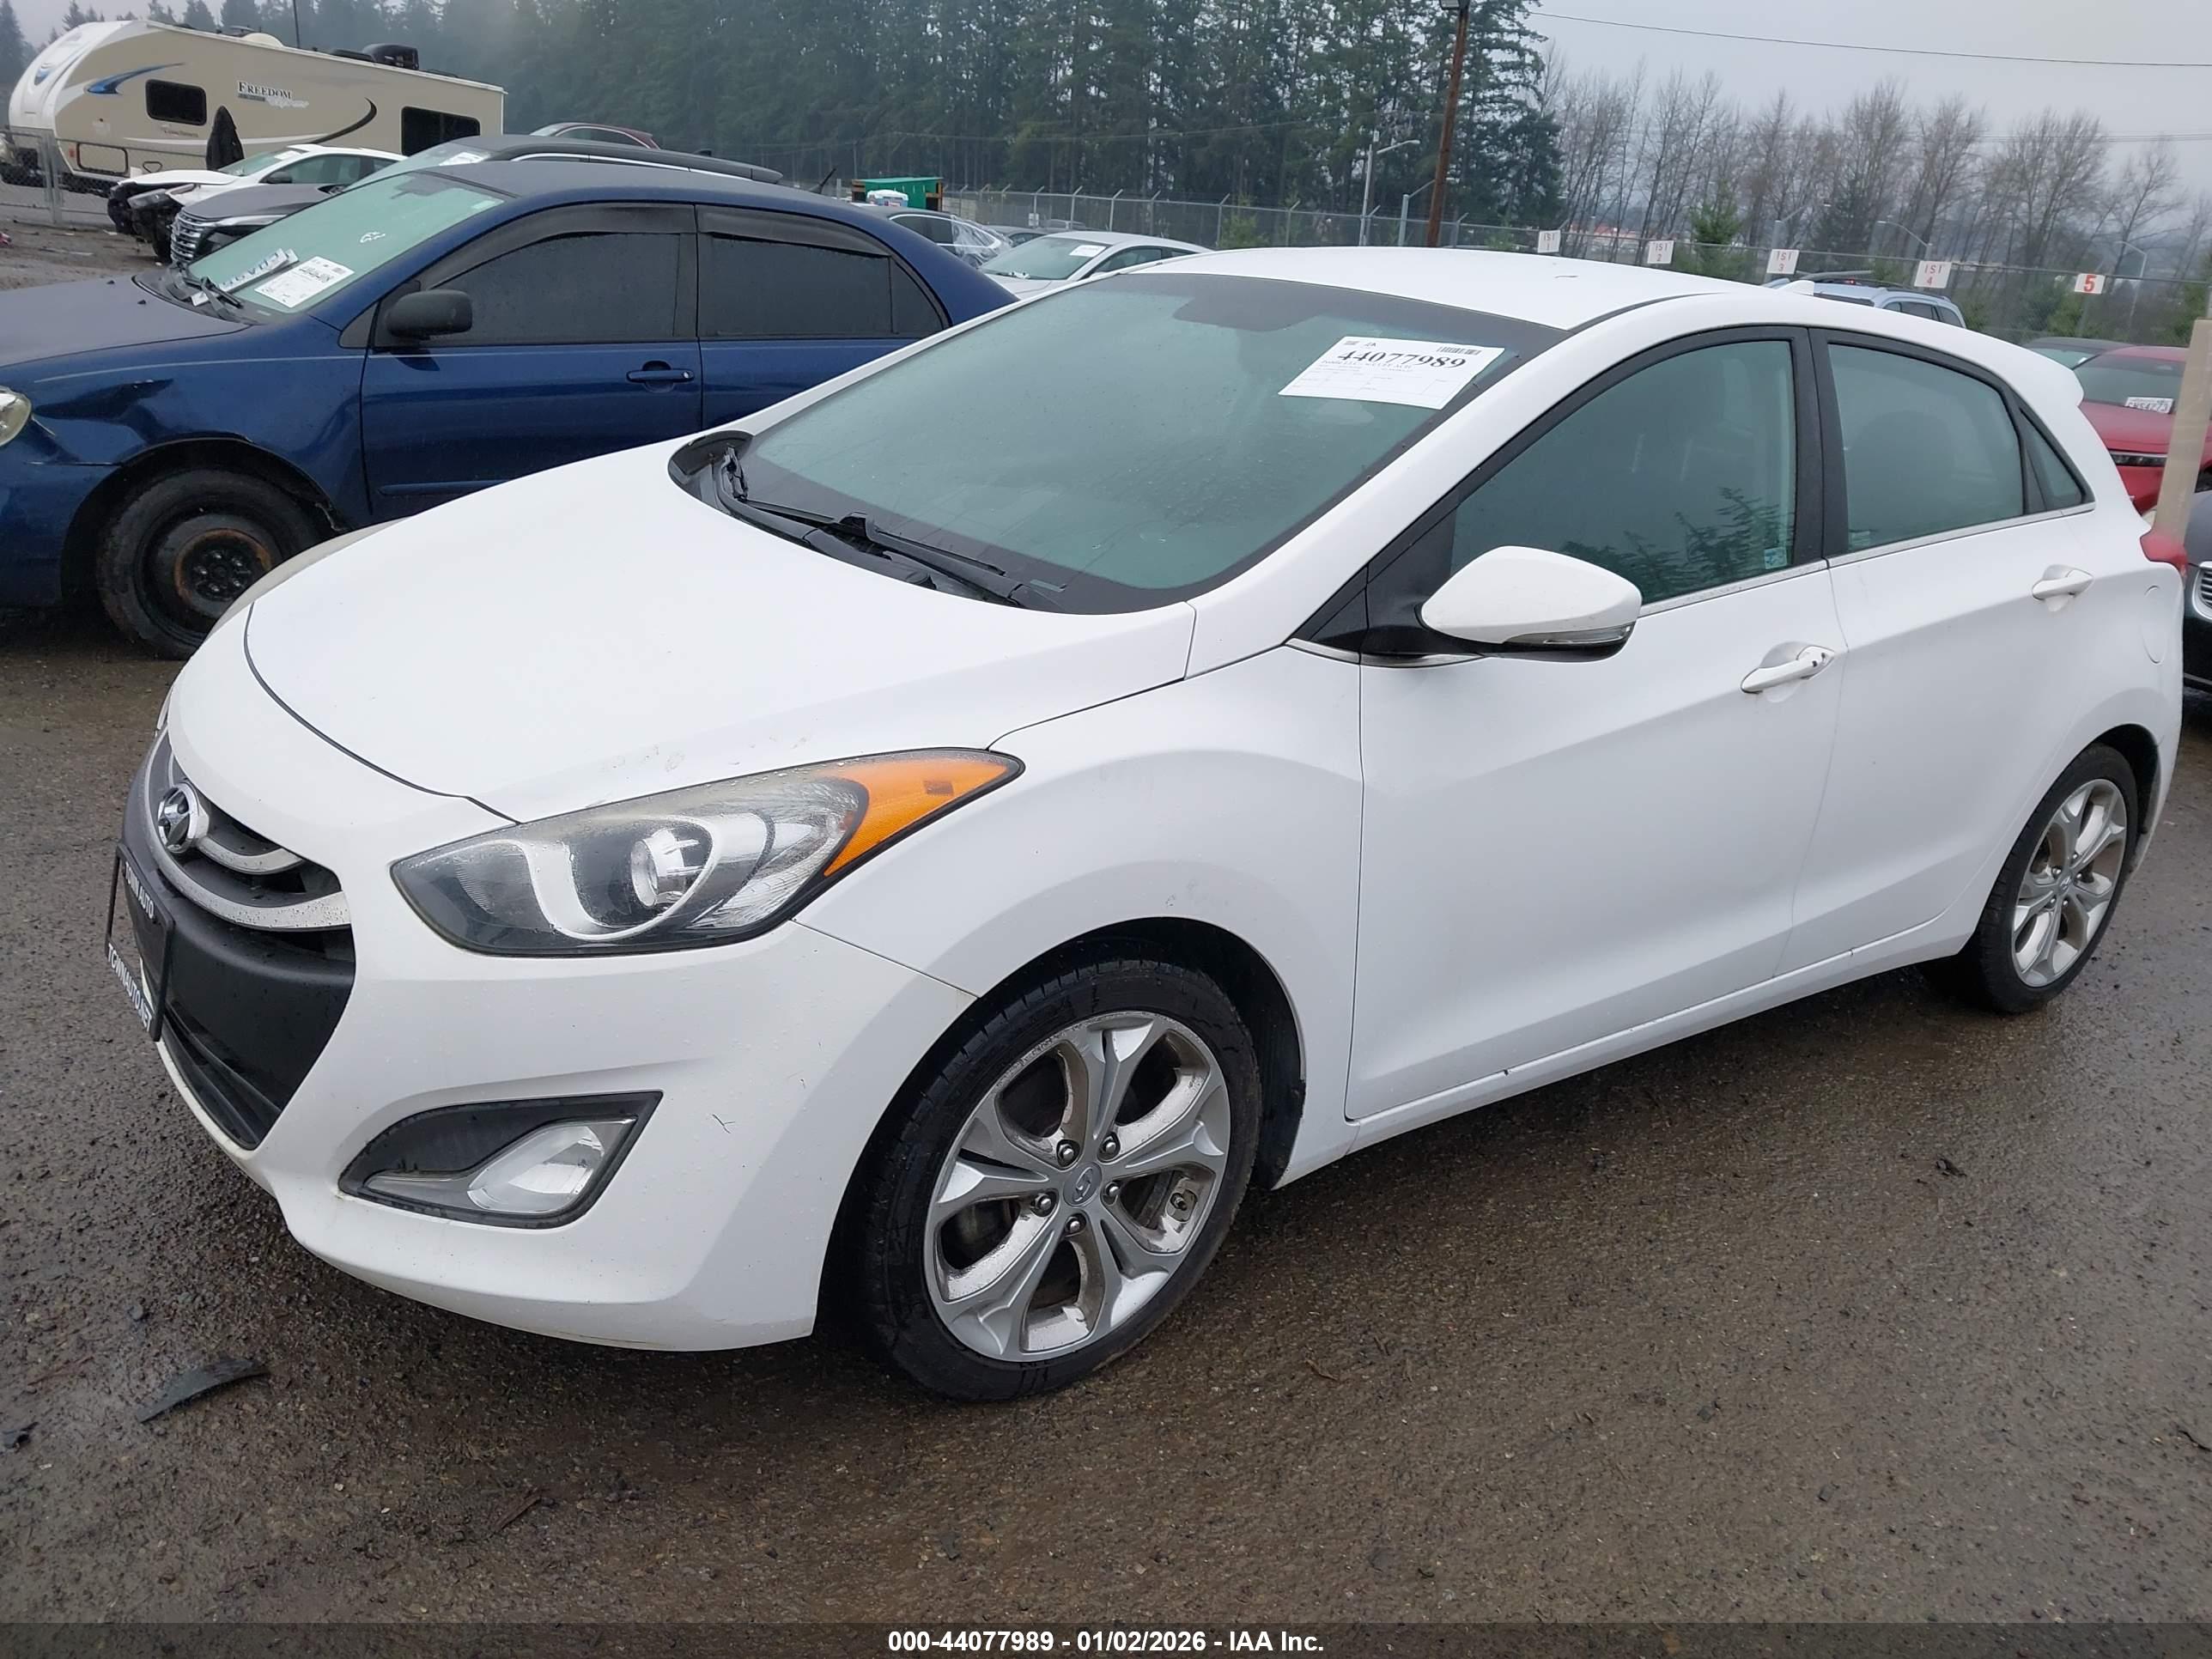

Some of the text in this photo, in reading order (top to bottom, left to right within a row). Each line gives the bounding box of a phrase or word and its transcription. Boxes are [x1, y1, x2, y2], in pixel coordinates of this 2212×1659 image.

[238, 82, 292, 100] FREEDOM
[1656, 253, 1663, 262] 2
[1778, 263, 1785, 272] 3
[1927, 276, 1933, 286] 4
[2084, 275, 2097, 292] 5
[1337, 349, 1467, 369] 44077989
[138, 885, 155, 920] AUTO
